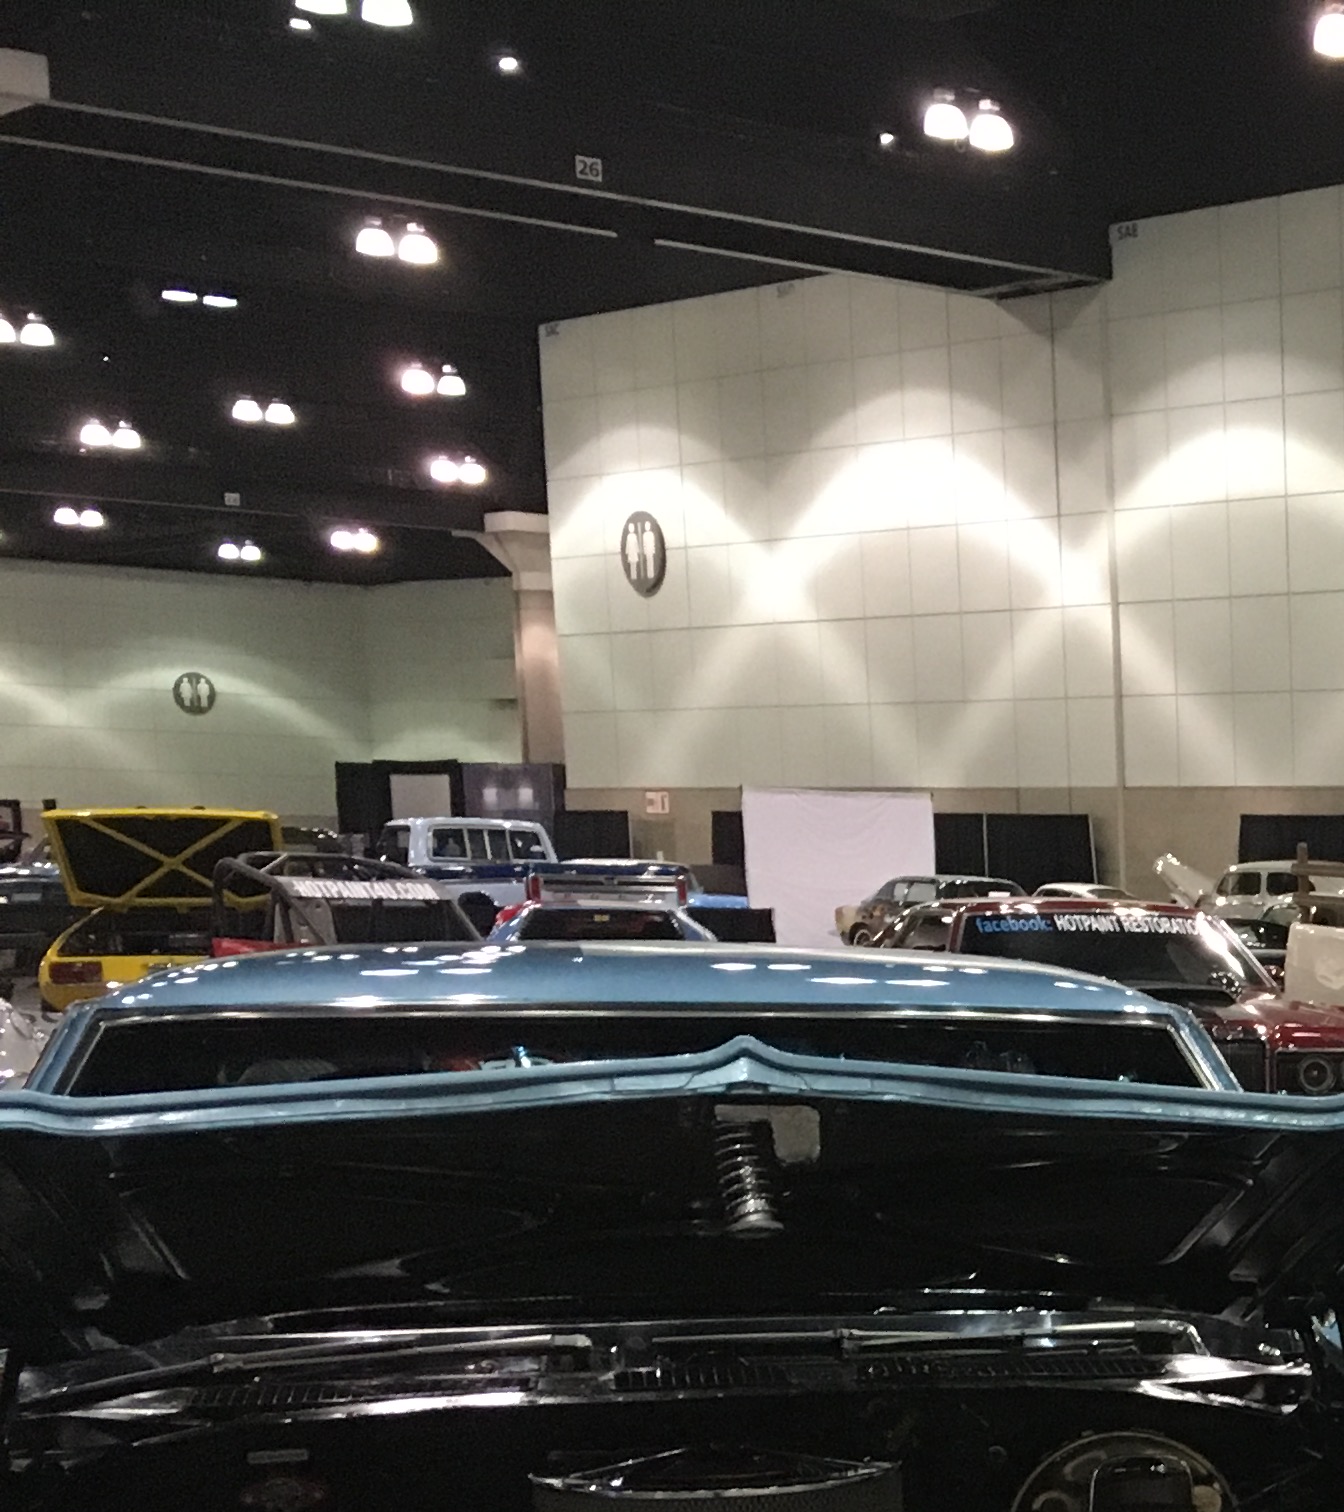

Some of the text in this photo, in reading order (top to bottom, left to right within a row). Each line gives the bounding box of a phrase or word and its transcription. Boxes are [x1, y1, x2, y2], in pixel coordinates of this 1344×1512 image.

[578, 159, 601, 178] 26
[976, 914, 1053, 933] facebook:
[1053, 914, 1121, 934] HOTPAINT
